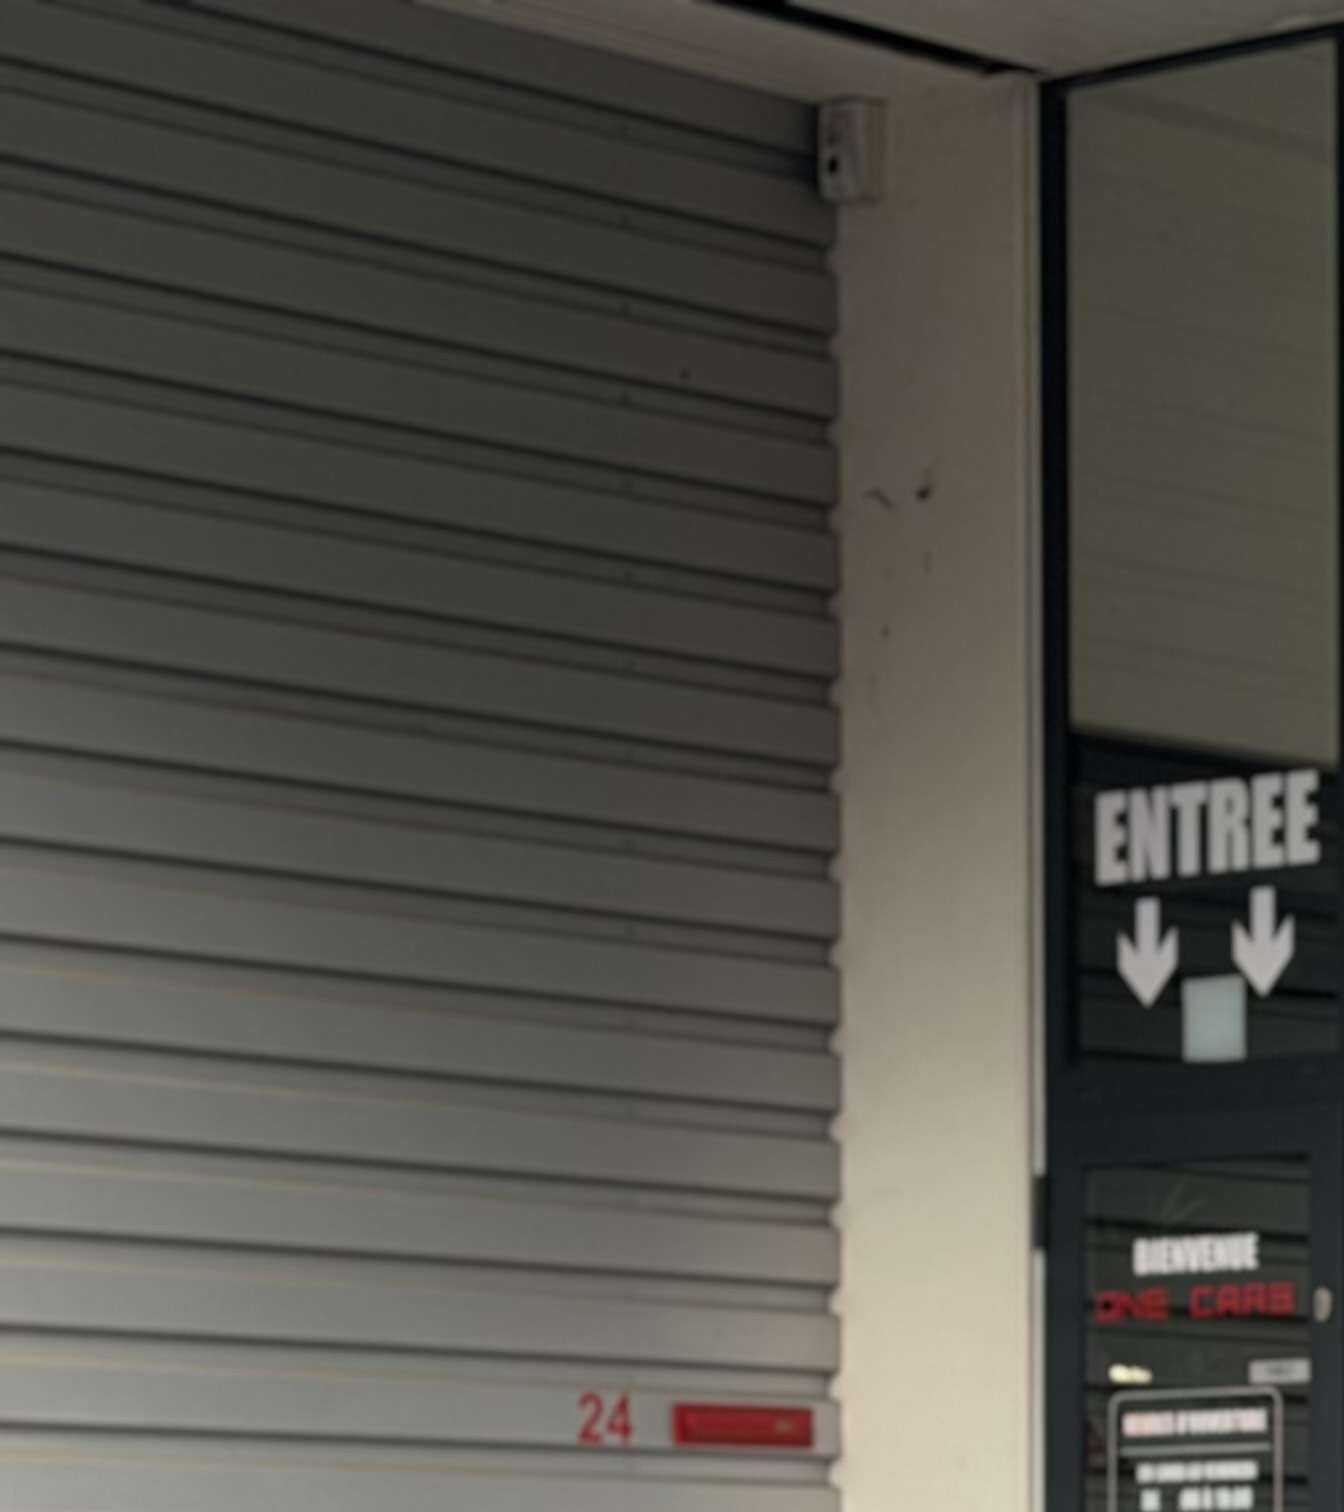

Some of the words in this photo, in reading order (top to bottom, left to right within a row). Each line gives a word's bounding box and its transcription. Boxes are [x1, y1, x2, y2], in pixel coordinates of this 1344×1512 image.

[1095, 768, 1321, 887] ENTREE
[1094, 1287, 1170, 1322] ONE
[1189, 1281, 1297, 1318] CARS
[578, 1392, 633, 1446] 24
